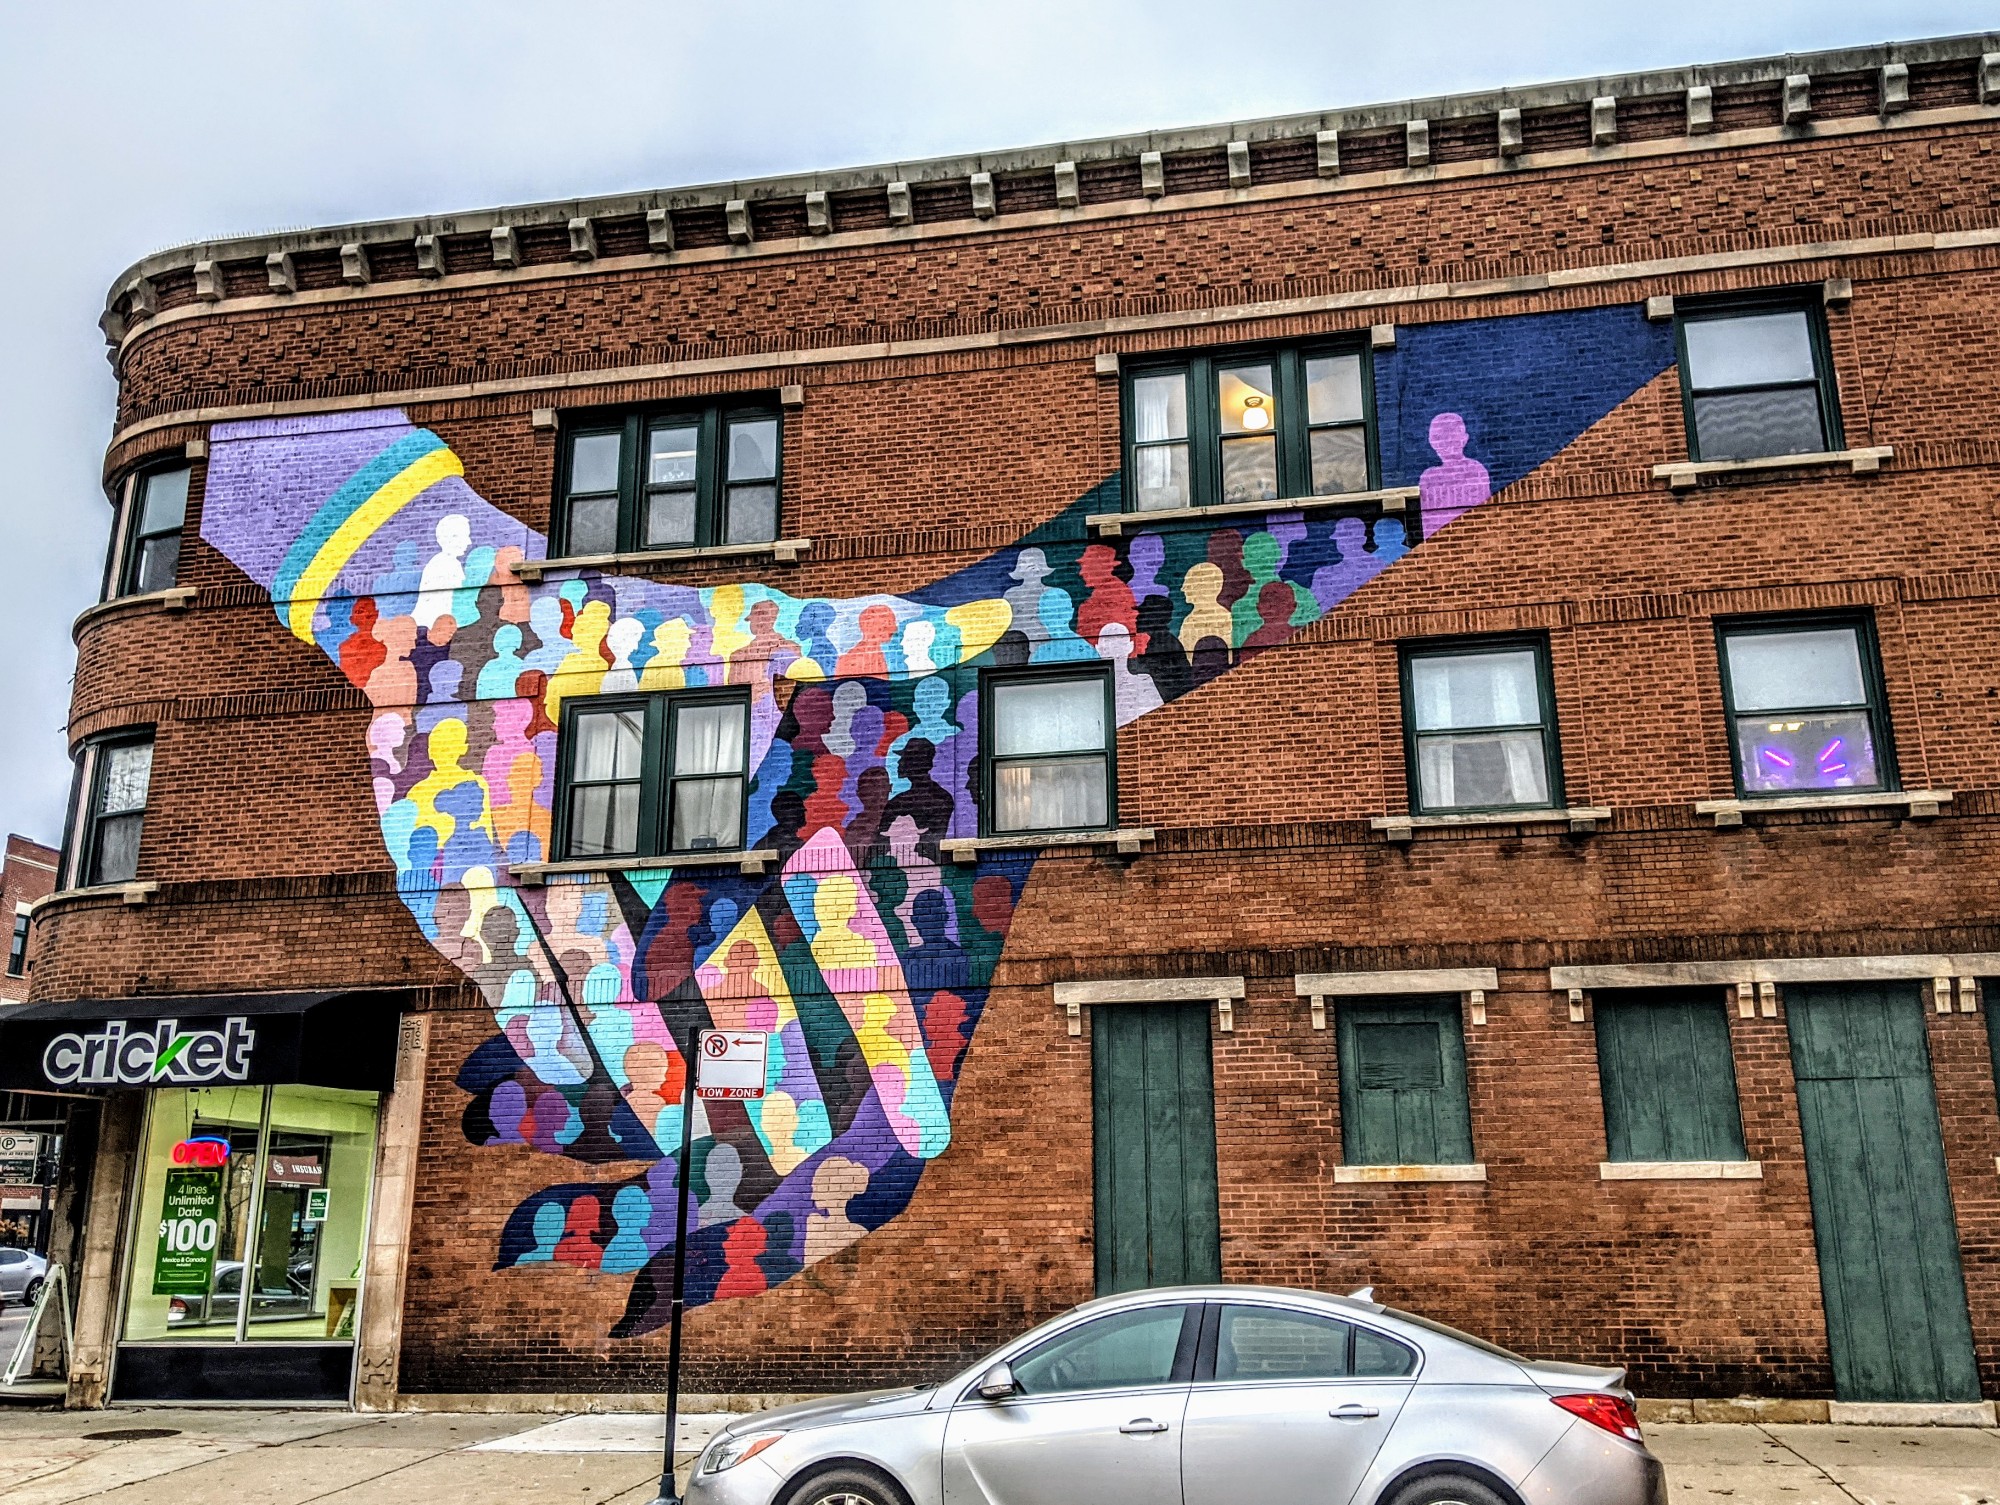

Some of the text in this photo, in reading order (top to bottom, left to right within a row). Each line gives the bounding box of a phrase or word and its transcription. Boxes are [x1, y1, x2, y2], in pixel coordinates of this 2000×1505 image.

[43, 1017, 255, 1084] cricket
[701, 1088, 759, 1097] TOW ZONE
[173, 1142, 227, 1166] OPEN
[178, 1185, 207, 1194] 4 lines
[168, 1195, 215, 1206] Unlimited
[177, 1207, 203, 1217] Data
[159, 1217, 217, 1252] $100
